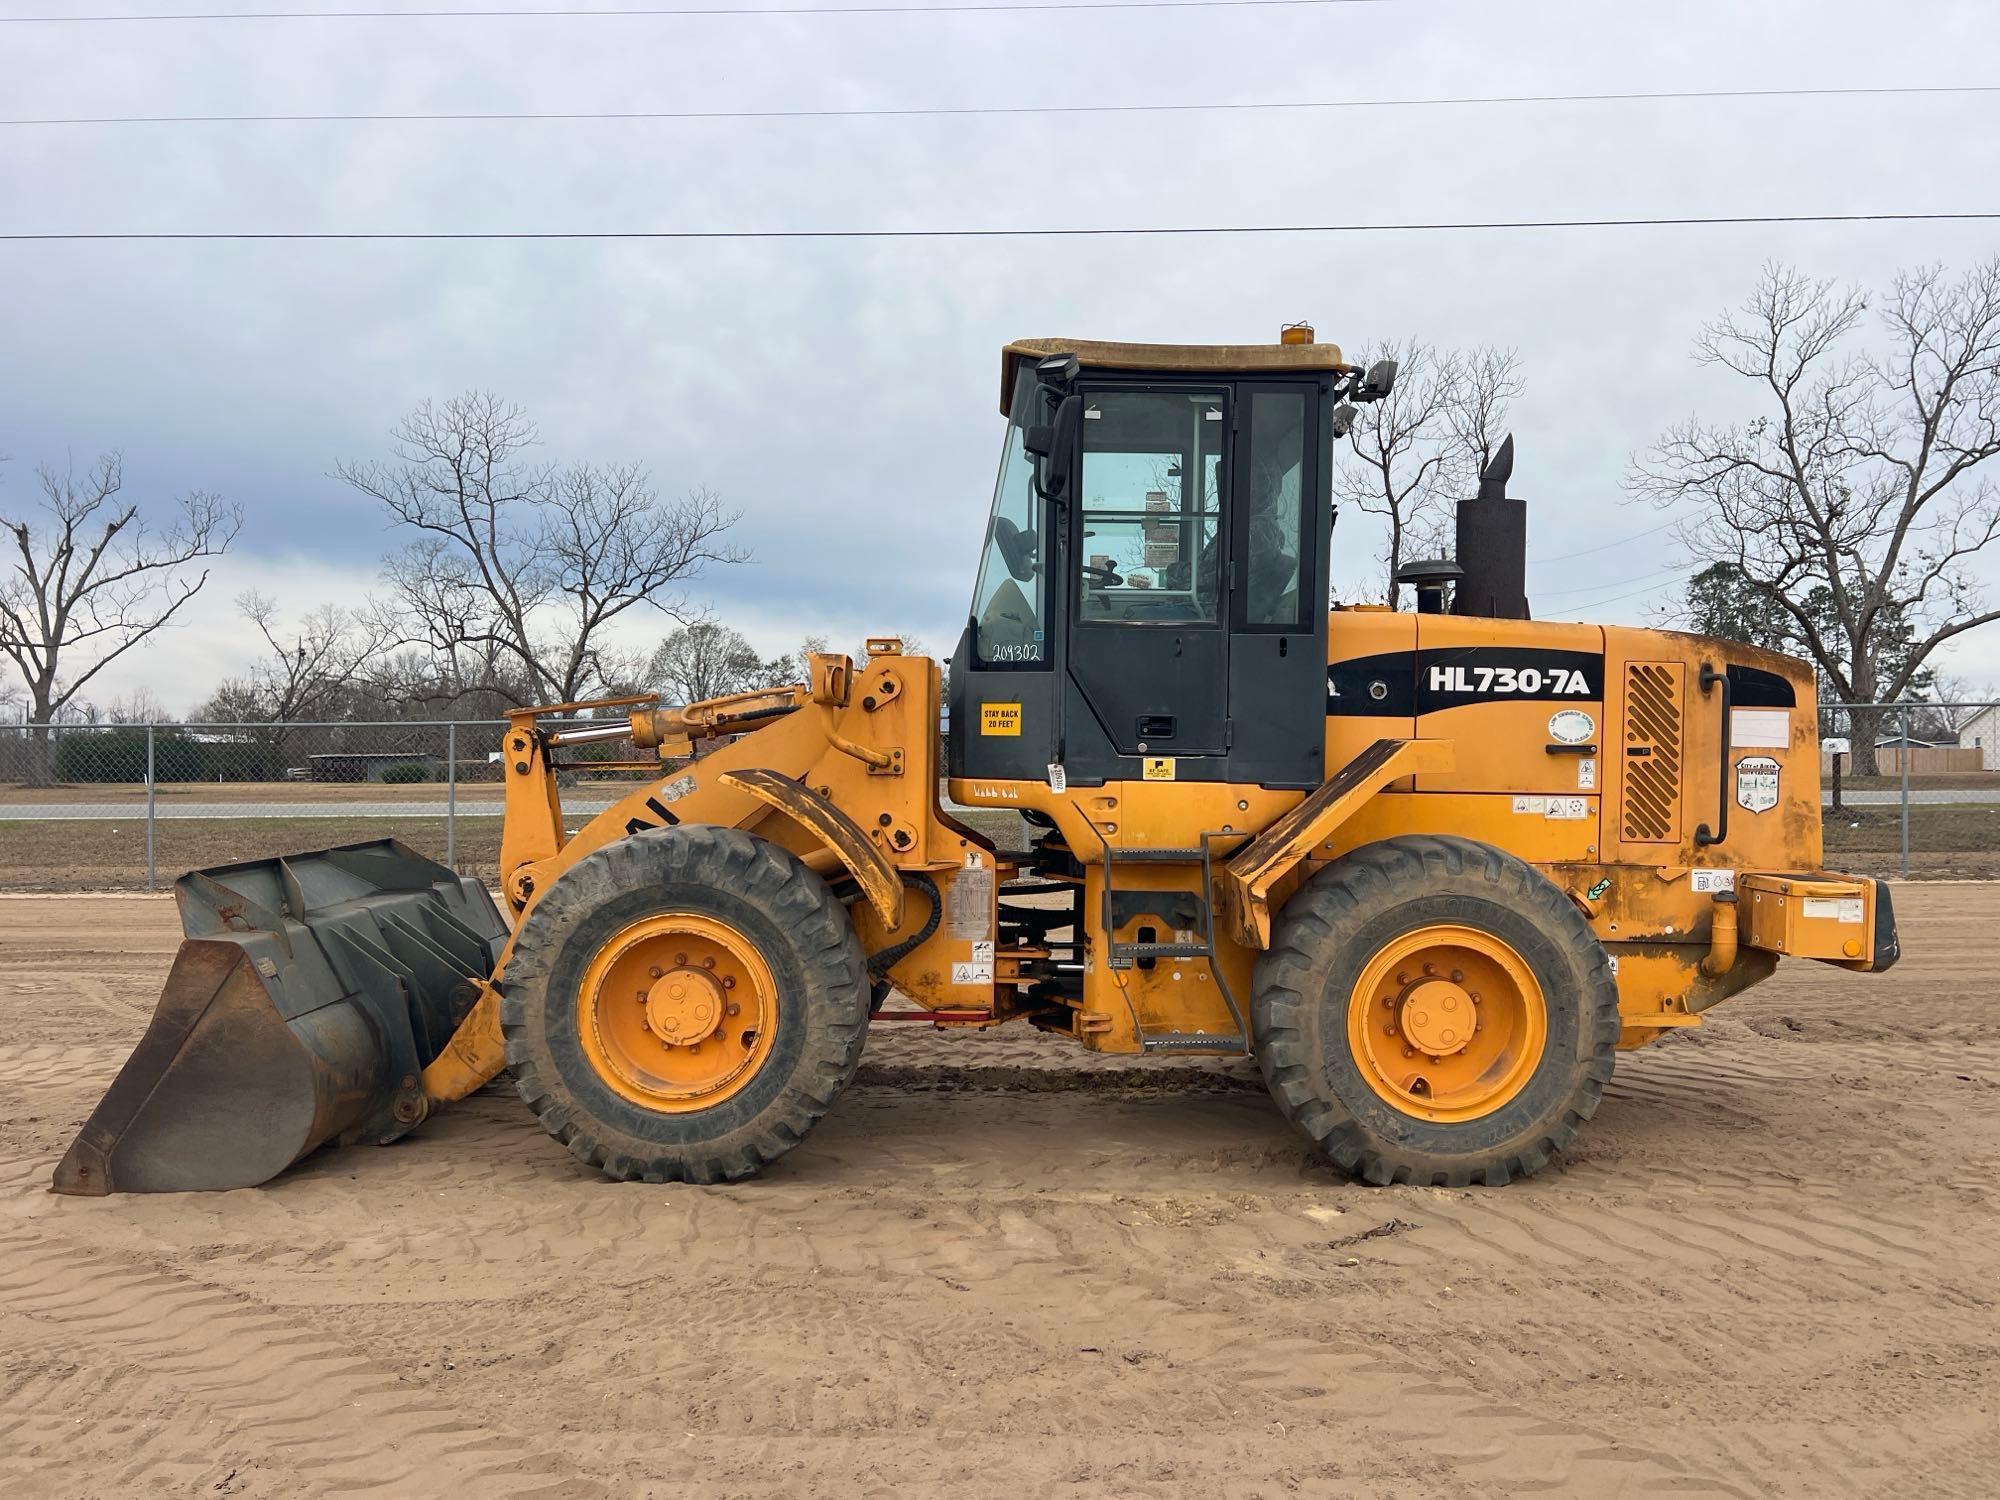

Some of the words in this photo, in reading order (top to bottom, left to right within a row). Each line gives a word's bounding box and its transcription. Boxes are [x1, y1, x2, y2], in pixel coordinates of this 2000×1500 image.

[993, 644, 1041, 662] 209302
[1430, 666, 1591, 694] HL730-7A
[984, 710, 1000, 718] STAY
[1001, 710, 1019, 718] BACK
[988, 720, 997, 728] 20
[998, 720, 1014, 728] FEET
